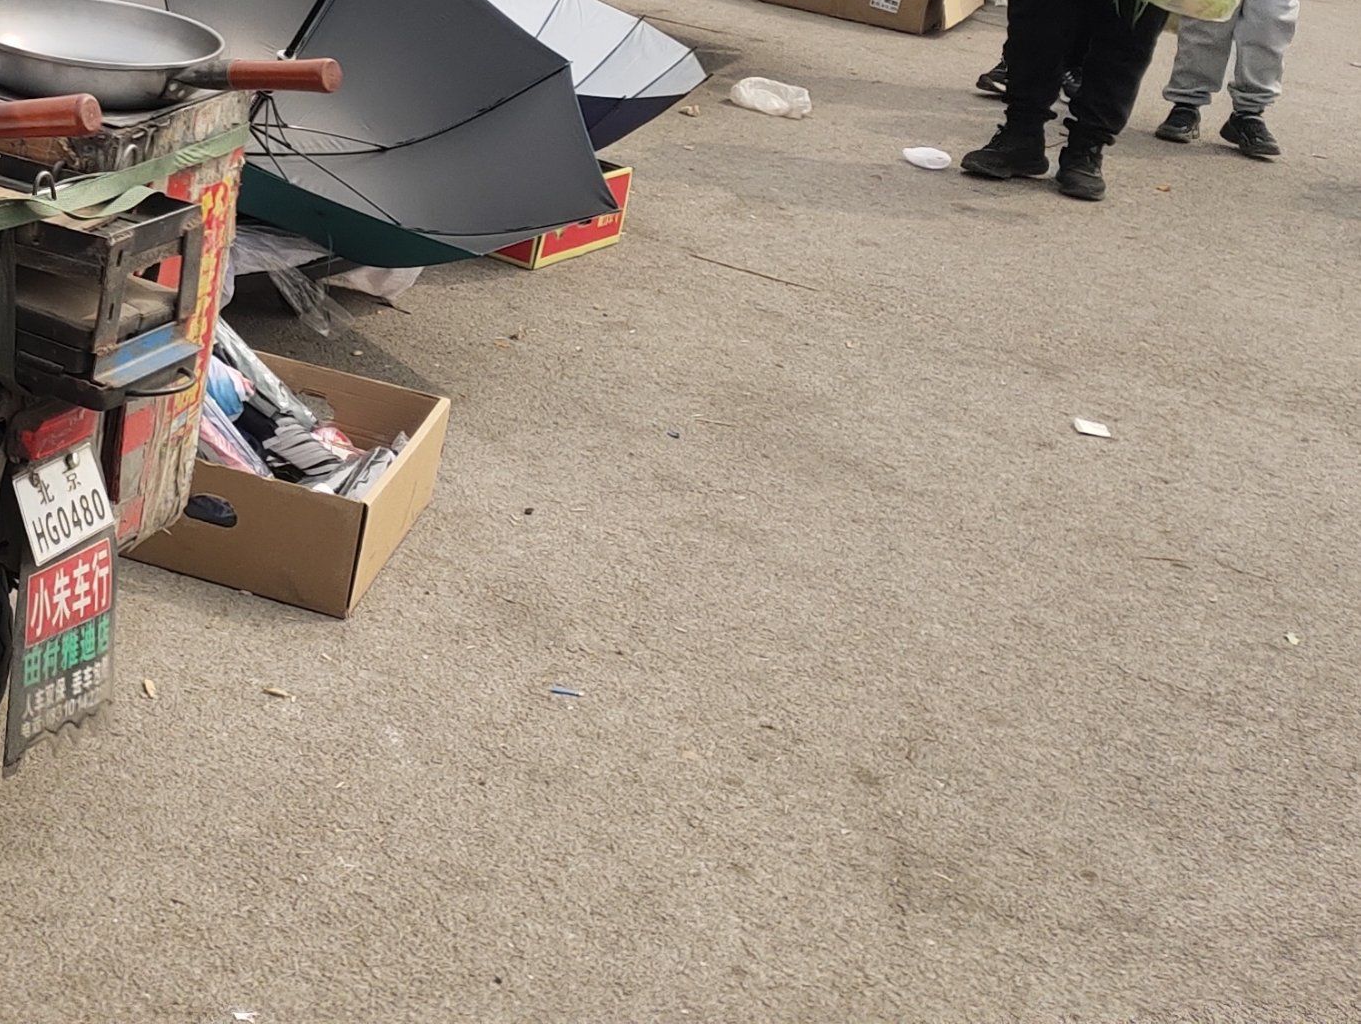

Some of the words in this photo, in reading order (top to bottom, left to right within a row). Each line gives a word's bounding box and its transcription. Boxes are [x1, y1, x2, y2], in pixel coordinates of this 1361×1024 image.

[38, 466, 82, 505] 北京
[32, 488, 105, 553] HG0480
[30, 549, 109, 637] 小朱车行
